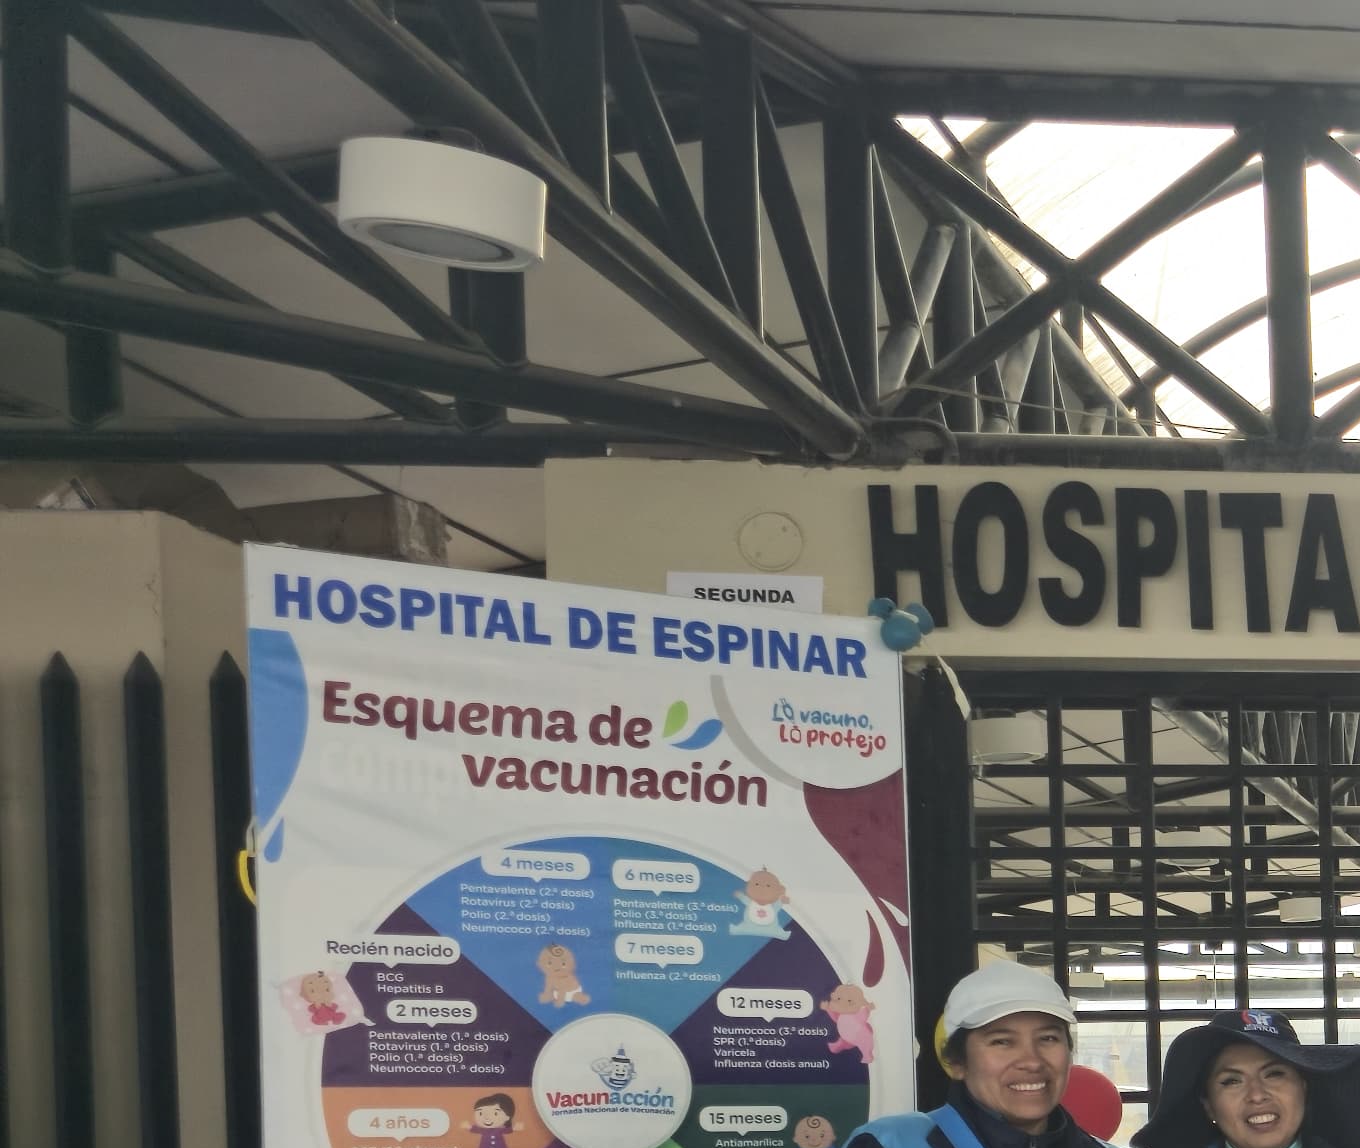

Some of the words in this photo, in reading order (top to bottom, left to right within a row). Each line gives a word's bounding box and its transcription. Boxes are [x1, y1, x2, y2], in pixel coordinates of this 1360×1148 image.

[694, 587, 795, 604] SEGUNDA
[274, 573, 552, 646] HOSPITAL
[568, 606, 637, 655] DE
[653, 616, 867, 678] ESPINAR
[323, 680, 578, 744] Esquema
[588, 704, 653, 750] de
[806, 727, 886, 757] protejo
[462, 754, 767, 807] vacunación
[501, 856, 512, 868] 4
[516, 858, 574, 872] meses
[625, 869, 635, 881] 6
[639, 871, 694, 884] meses
[326, 940, 388, 956] Recién
[394, 945, 454, 958] nacido
[627, 942, 636, 954] 7
[640, 944, 695, 956] meses
[377, 972, 404, 982] BCG
[377, 984, 431, 994] Hepatitis
[435, 985, 444, 993] B
[730, 996, 745, 1008] 12
[750, 998, 802, 1010] meses
[396, 1004, 406, 1017] 2
[412, 1006, 472, 1018] meses
[369, 1031, 447, 1041] Pentavalente
[474, 1032, 509, 1042] dosis)
[714, 1048, 756, 1058] Varicela
[546, 1087, 674, 1109] Vacunacción
[370, 1117, 380, 1128] 4
[386, 1116, 430, 1129] años
[709, 1113, 725, 1124] 15
[729, 1114, 782, 1125] meses
